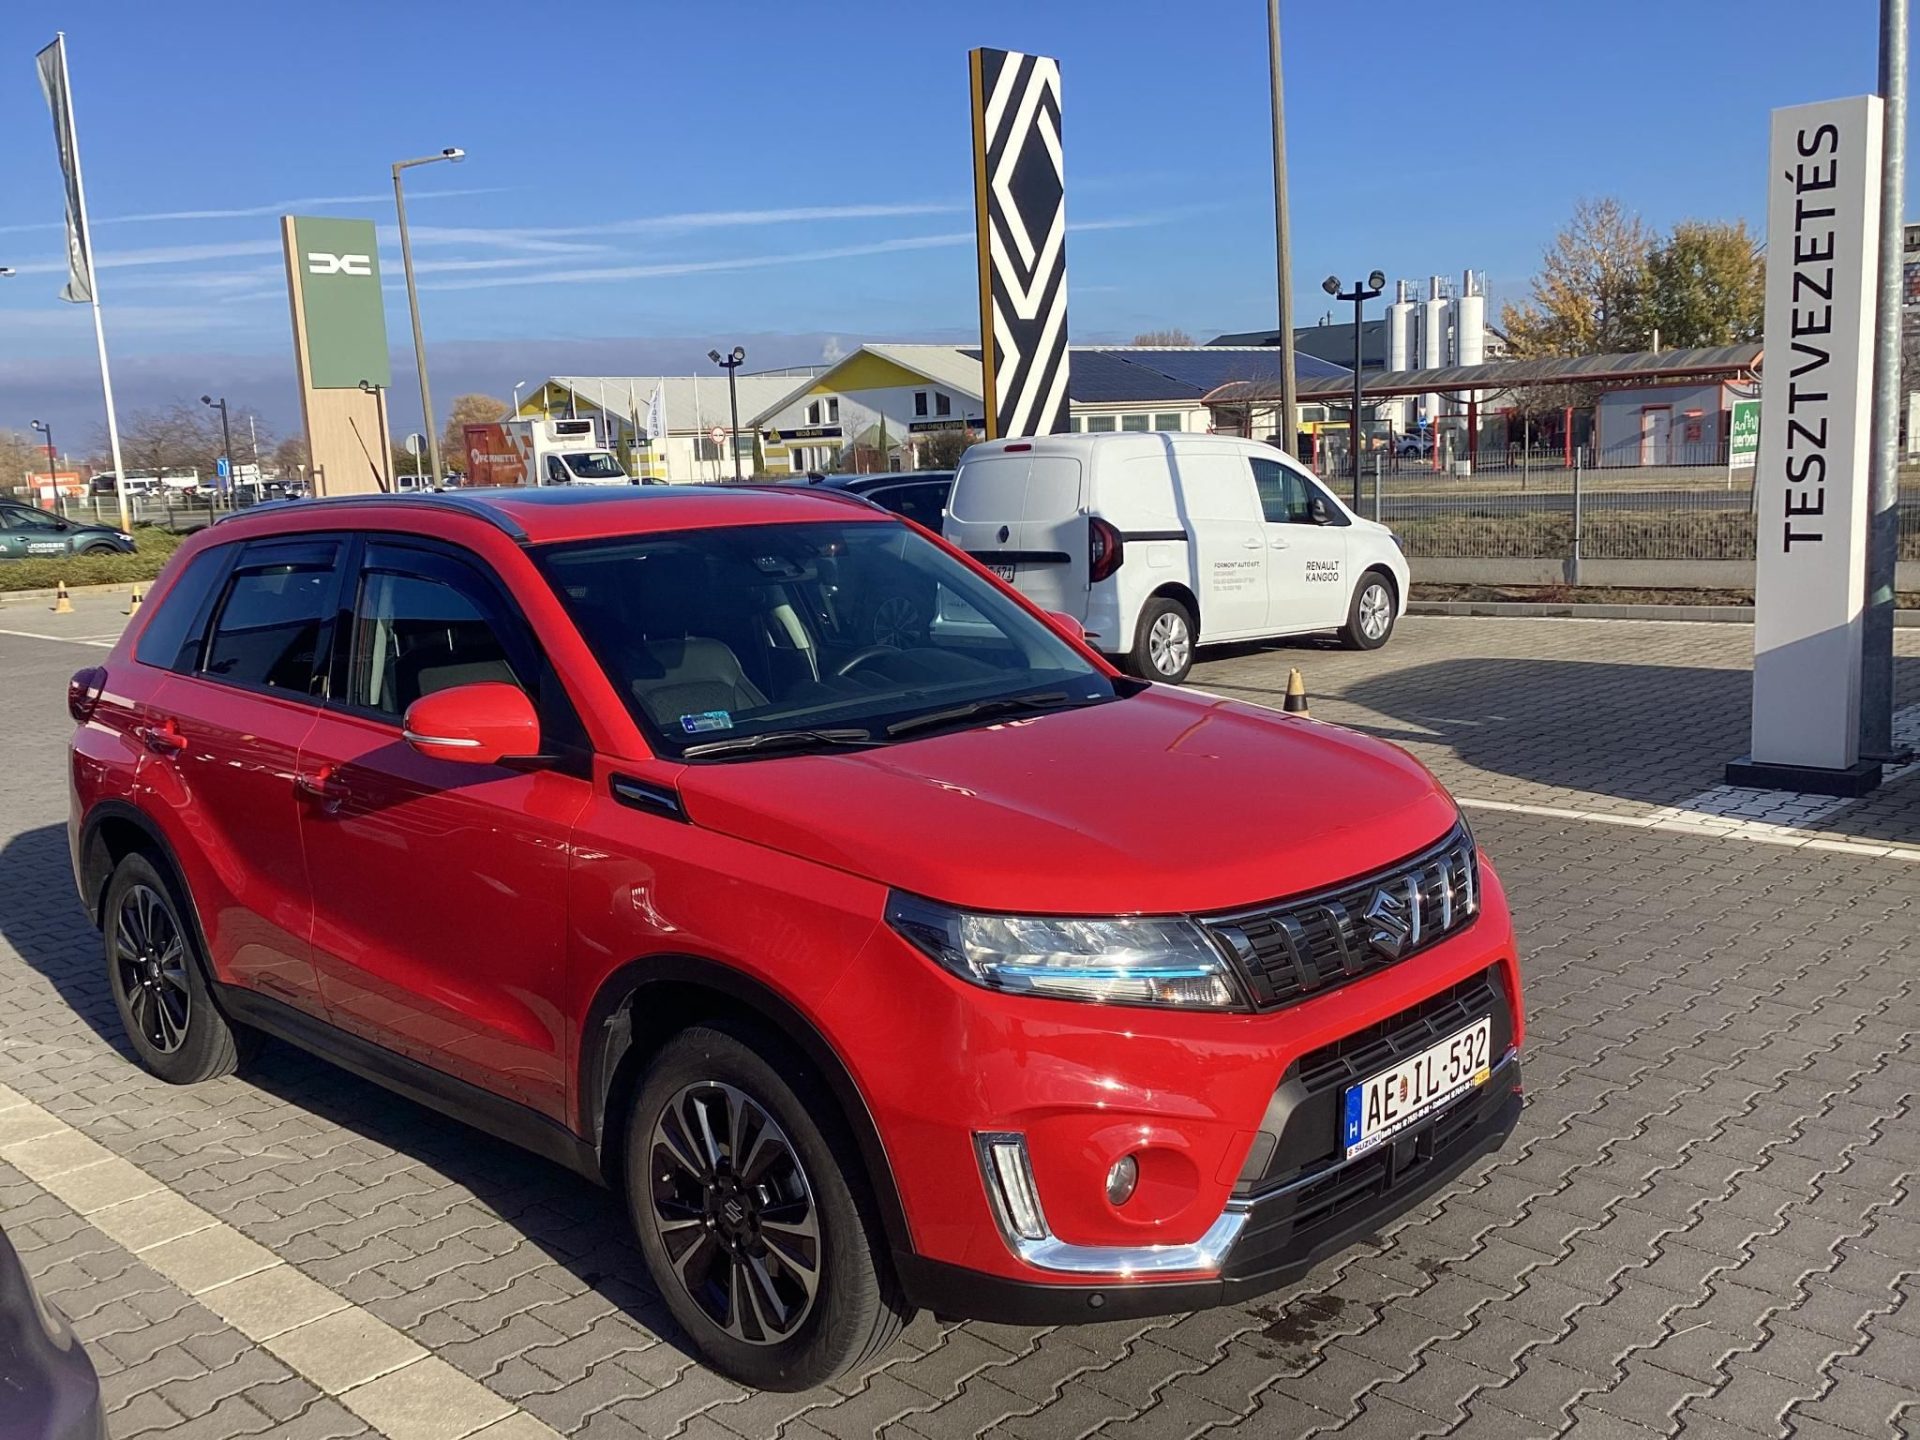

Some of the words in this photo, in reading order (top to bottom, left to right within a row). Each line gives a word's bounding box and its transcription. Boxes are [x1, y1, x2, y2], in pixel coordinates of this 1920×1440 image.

[1783, 124, 1839, 553] TESZTVEZETÉS
[1305, 560, 1340, 571] RENAULT
[1305, 571, 1340, 582] KANGOO
[1367, 1073, 1398, 1131] AE
[1349, 1120, 1358, 1139] H
[1354, 1132, 1381, 1154] SUZUKI
